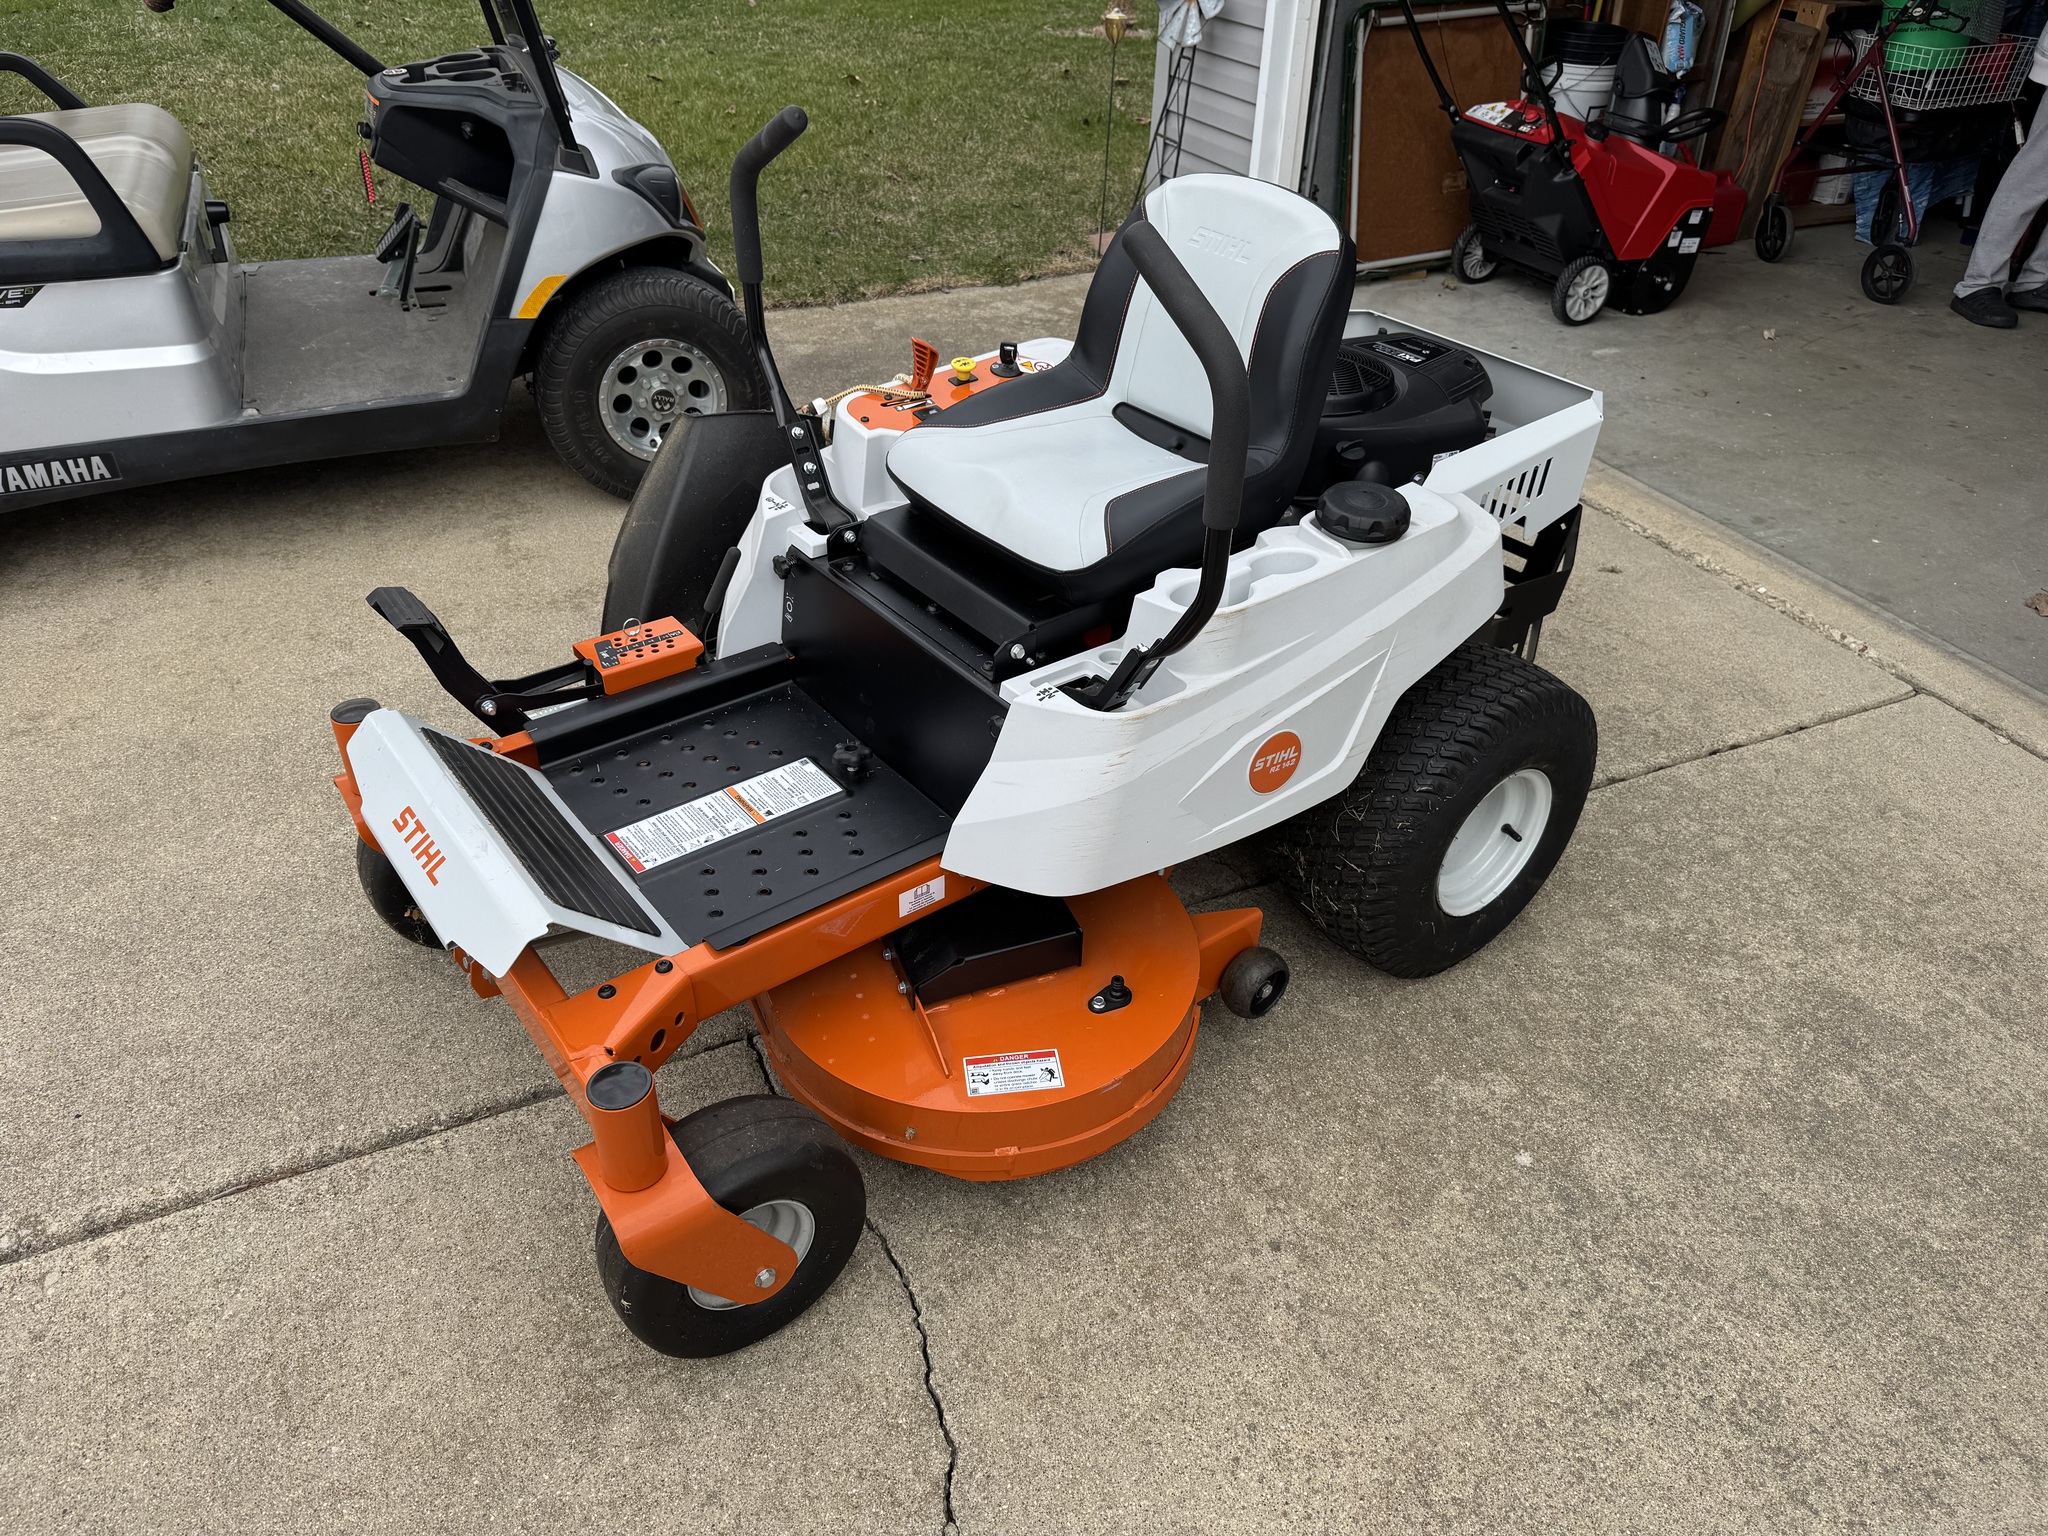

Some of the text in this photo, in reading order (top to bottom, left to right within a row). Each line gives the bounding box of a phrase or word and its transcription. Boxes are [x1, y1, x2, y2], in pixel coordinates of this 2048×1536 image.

[1187, 226, 1251, 264] STIHL
[1254, 746, 1298, 772] STIHL
[1270, 764, 1281, 774] RZ
[733, 794, 754, 812] WARNING
[392, 806, 446, 886] STIHL
[616, 840, 632, 859] DANGER
